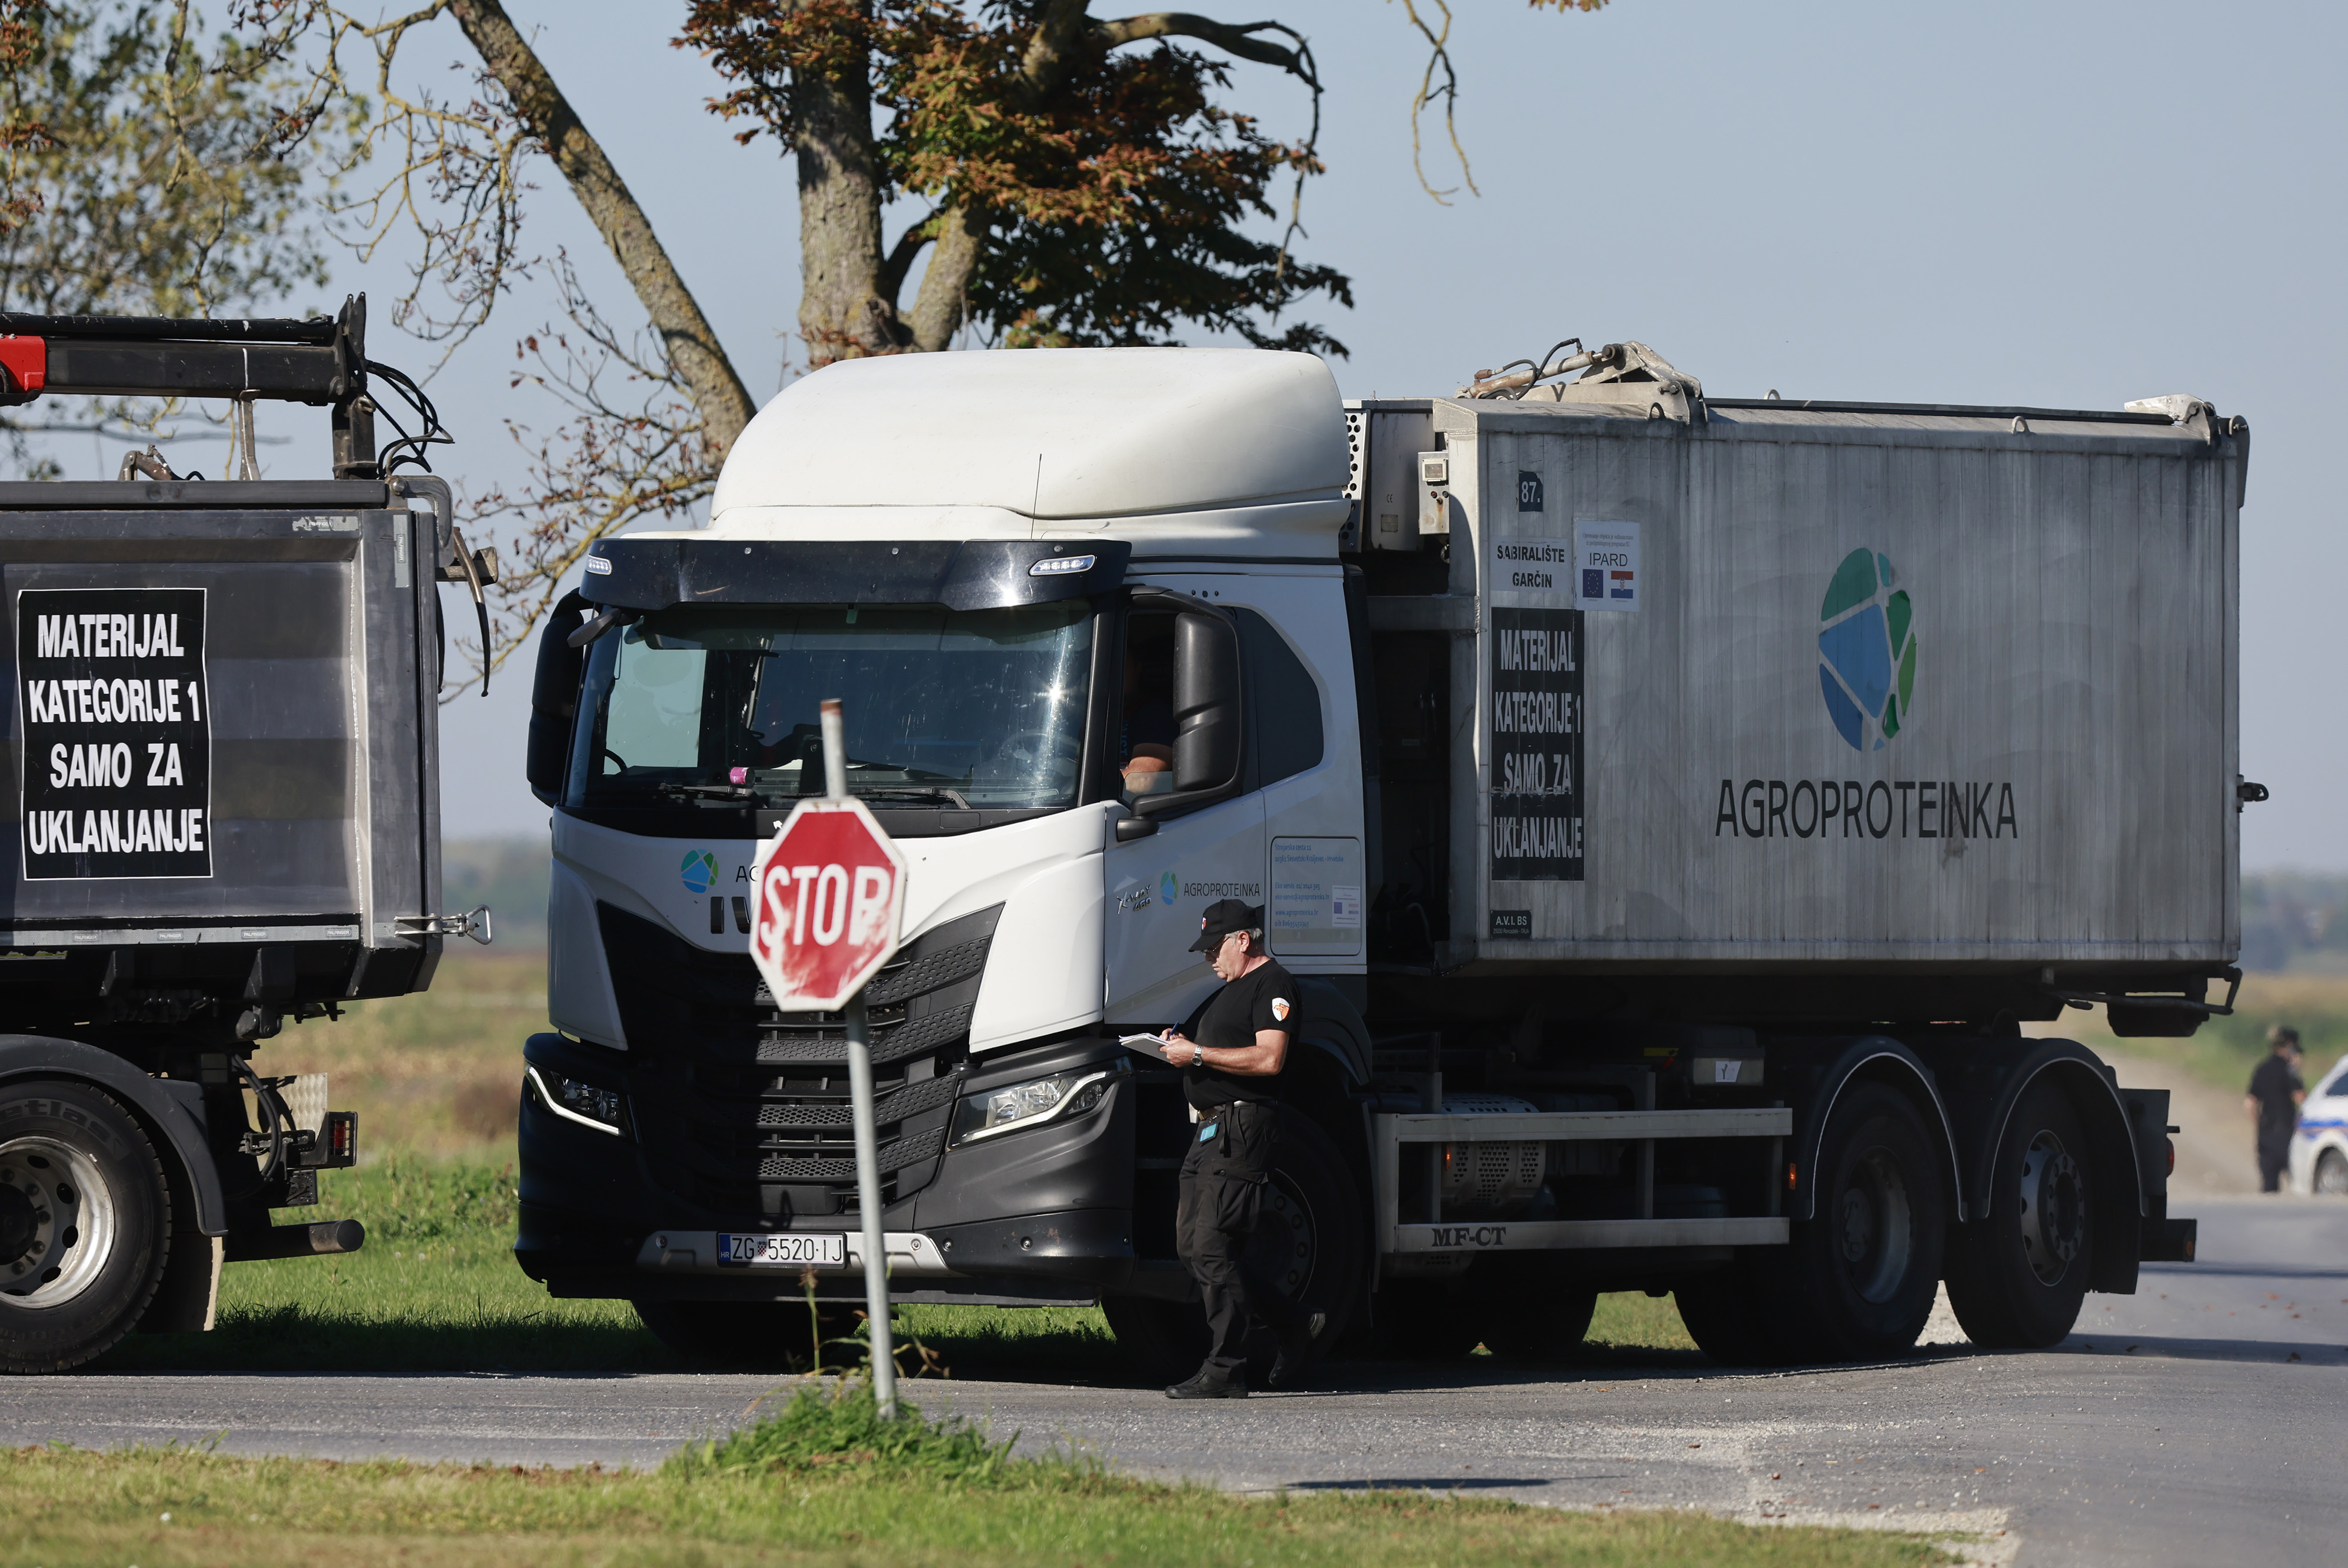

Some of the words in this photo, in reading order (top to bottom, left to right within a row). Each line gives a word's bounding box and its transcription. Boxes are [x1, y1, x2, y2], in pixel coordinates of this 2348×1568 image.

[1497, 545, 1565, 562] SABIRALIŠTE
[1589, 552, 1627, 566] IPARD
[38, 613, 184, 658] MATERIJAL
[1500, 629, 1576, 672] MATERIJAL
[29, 679, 181, 723] KATEGORIJE
[187, 680, 200, 722] 1
[1495, 692, 1572, 734] KATEGORIJE
[1576, 695, 1581, 733] 1
[50, 743, 132, 788] SAMO
[147, 743, 184, 786] ZA
[1504, 752, 1546, 795] SAMO
[1553, 753, 1572, 795] ZA
[1715, 779, 2017, 839] AGROPROTEINKA
[29, 808, 204, 853] UKLANJANJE
[1275, 843, 1295, 852] Strojarska
[1494, 816, 1582, 859] UKLANJANJE
[1275, 855, 1286, 863] 10361
[1306, 855, 1324, 864] Kraljevec
[760, 863, 892, 948] STOP
[1116, 885, 1151, 915] X-WAY
[1133, 897, 1151, 911] 460
[1184, 883, 1260, 896] AGROPROTEINKA
[1496, 916, 1515, 925] A.V.I.
[1517, 916, 1527, 925] BS
[0, 1100, 111, 1142] etlas
[732, 1237, 755, 1260] ZG
[1431, 1226, 1506, 1247] MF-CT
